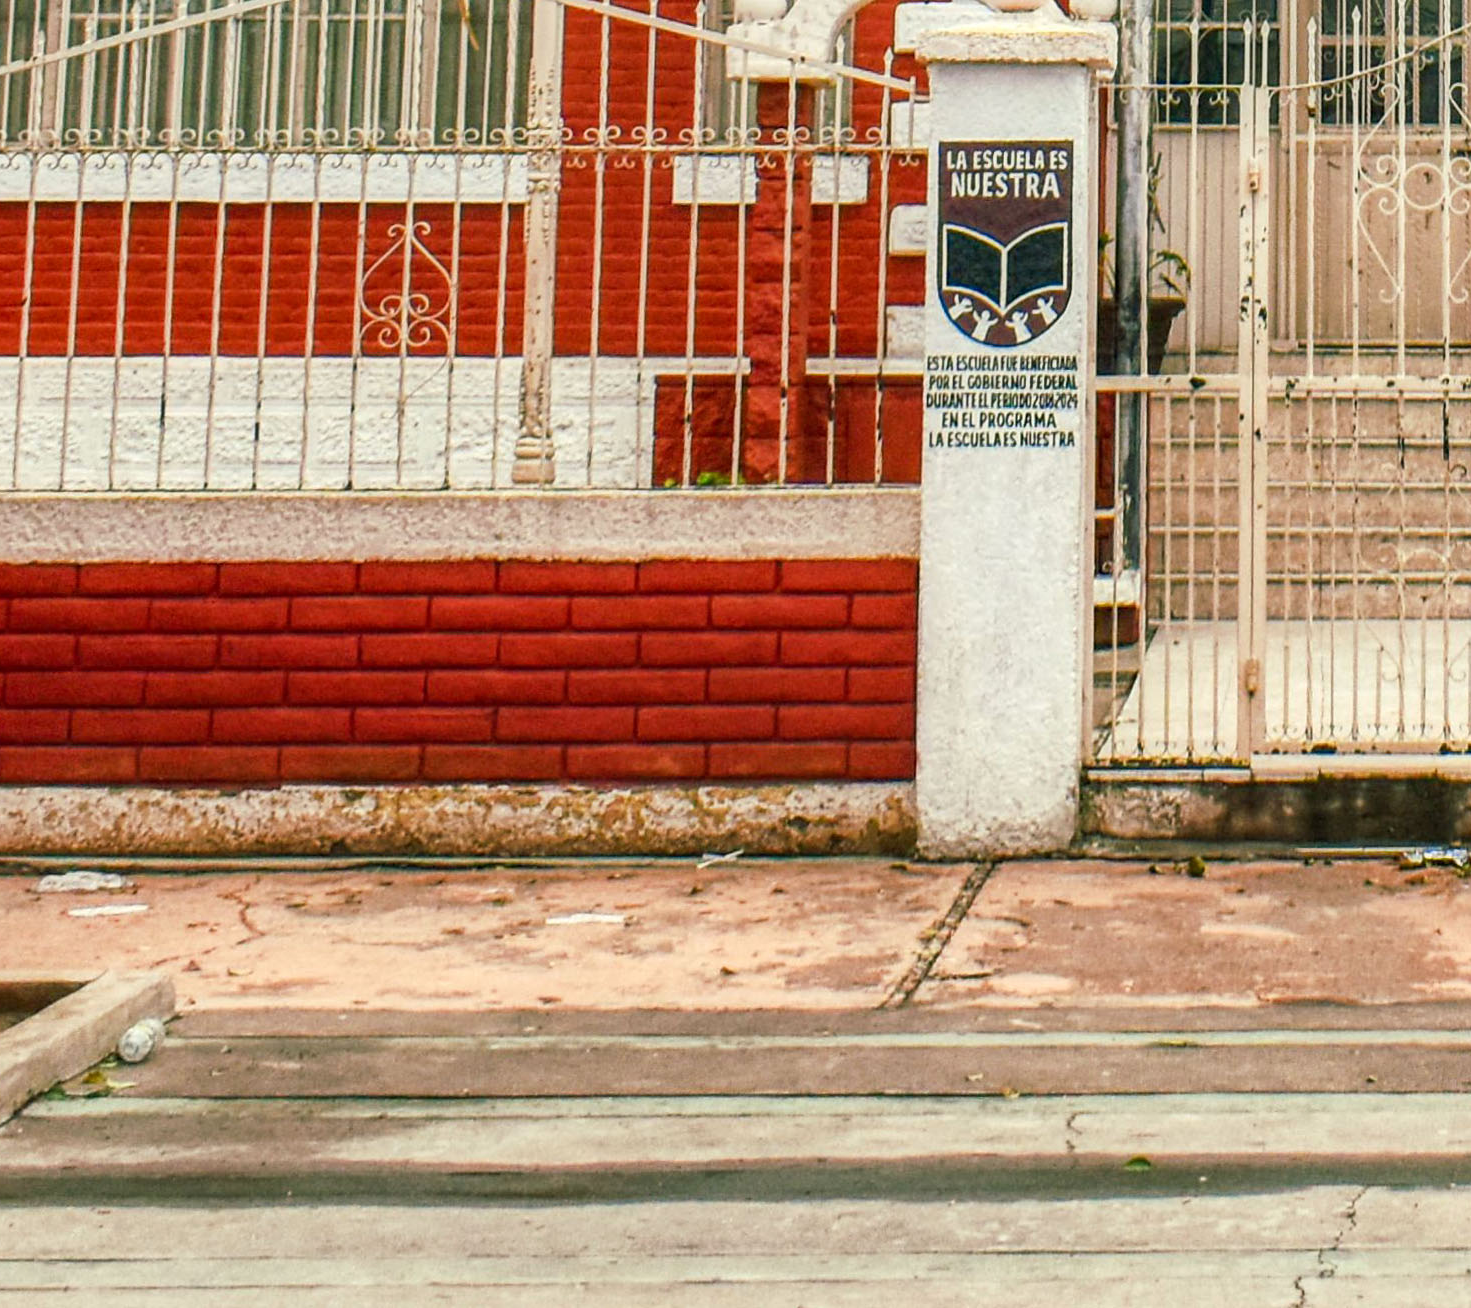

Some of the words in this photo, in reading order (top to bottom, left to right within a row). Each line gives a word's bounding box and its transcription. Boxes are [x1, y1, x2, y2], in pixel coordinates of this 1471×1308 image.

[946, 150, 967, 170] LA
[972, 149, 1045, 170] ESCUELA
[1049, 149, 1068, 170] ES
[950, 171, 1060, 198] NUESTRA
[927, 355, 954, 371] ESTA
[956, 355, 1001, 371] ESCUELA
[1000, 355, 1018, 371] FUE
[1020, 355, 1078, 371] BENEFICIADA
[929, 374, 950, 390] POR
[952, 374, 965, 390] EL
[967, 374, 1027, 390] GOBIERNO
[1029, 374, 1078, 390] FEDERAL
[926, 392, 977, 409] DURANTE
[978, 392, 989, 408] EL
[990, 392, 1033, 409] PERIODO
[941, 411, 959, 428] EN
[962, 412, 975, 428] EL
[979, 412, 1057, 428] PROGRAMA
[929, 431, 944, 448] LA
[947, 431, 1003, 448] ESCUELA
[1003, 431, 1017, 448] ES
[1020, 431, 1075, 448] NUESTRA
